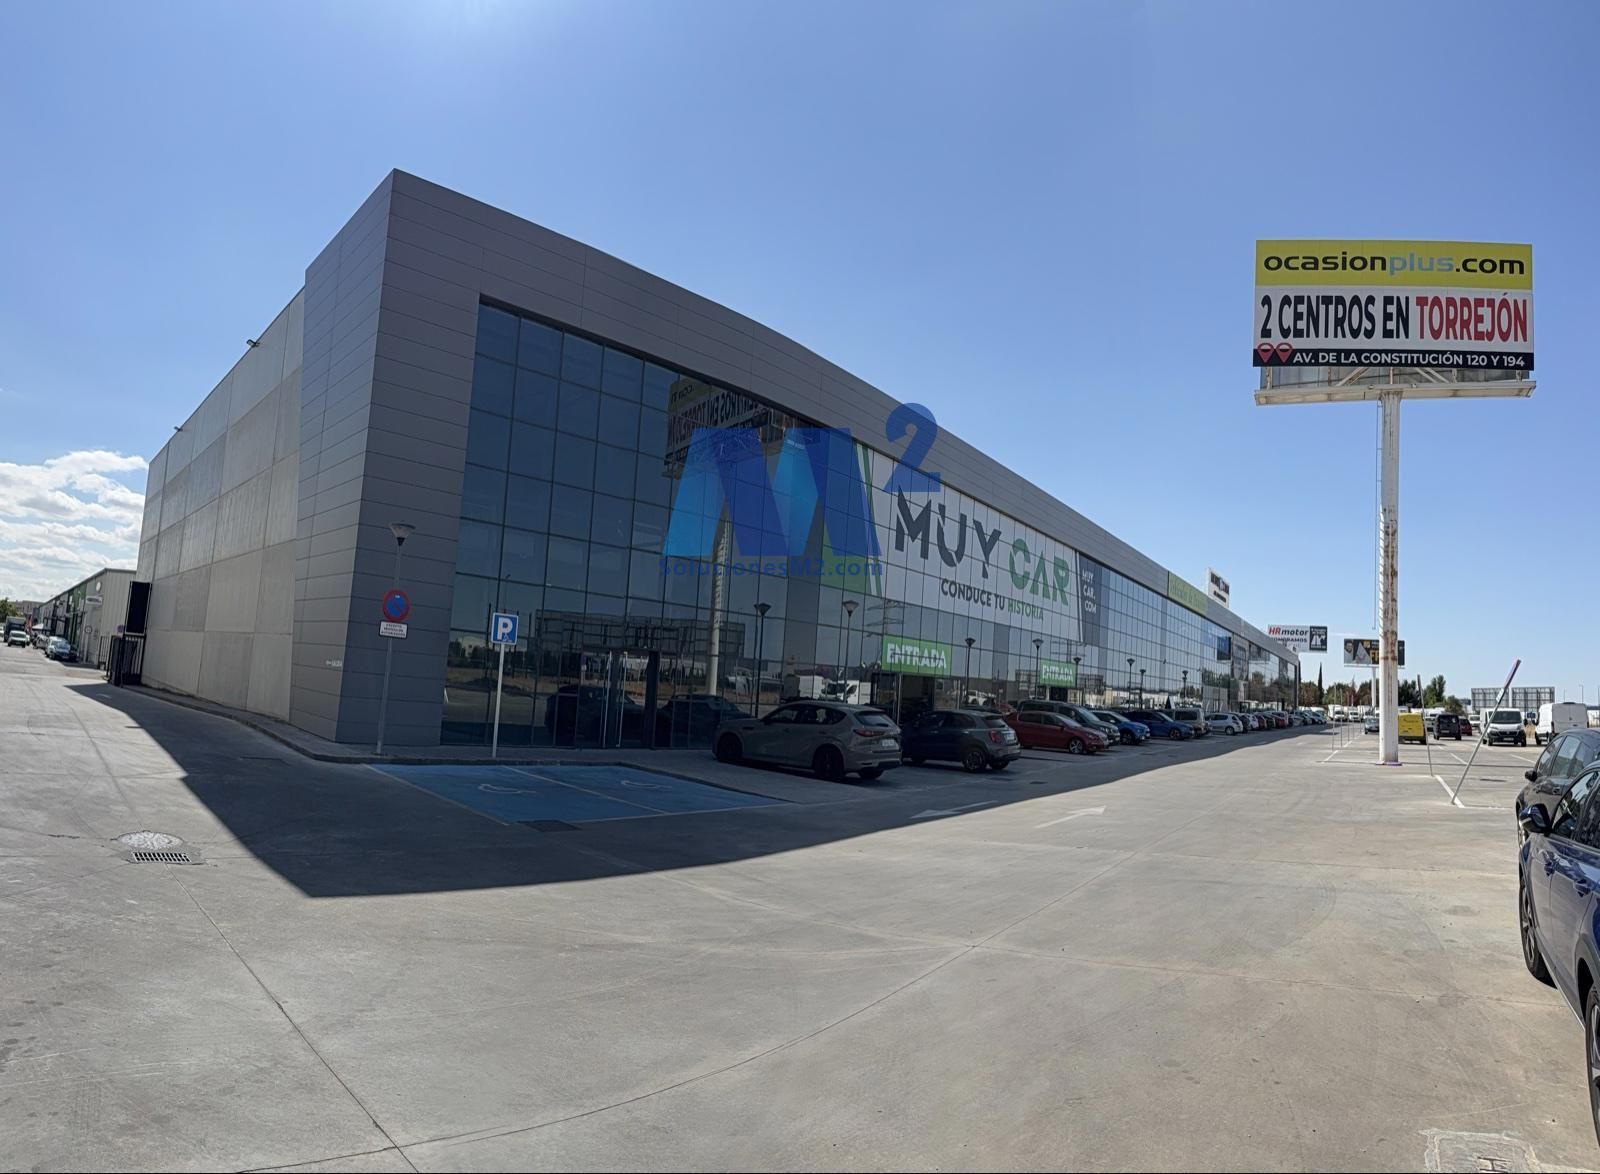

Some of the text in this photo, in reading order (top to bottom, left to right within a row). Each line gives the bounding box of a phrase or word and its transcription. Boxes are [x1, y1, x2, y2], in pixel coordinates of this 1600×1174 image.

[1264, 251, 1525, 276] ocasionplus.com
[1260, 292, 1528, 343] 2 CENTROS EN TORREJÓN
[1293, 350, 1525, 368] AV. DE LA CONSTITUCIÓN 120 Y 194
[895, 485, 1069, 606] MUY CAR
[941, 577, 1044, 622] CONDUCE TU HISTORIA
[497, 617, 513, 640] P
[1268, 627, 1309, 636] HR motor
[886, 642, 947, 669] ENTRADA
[1042, 663, 1074, 682] ENTRADA
